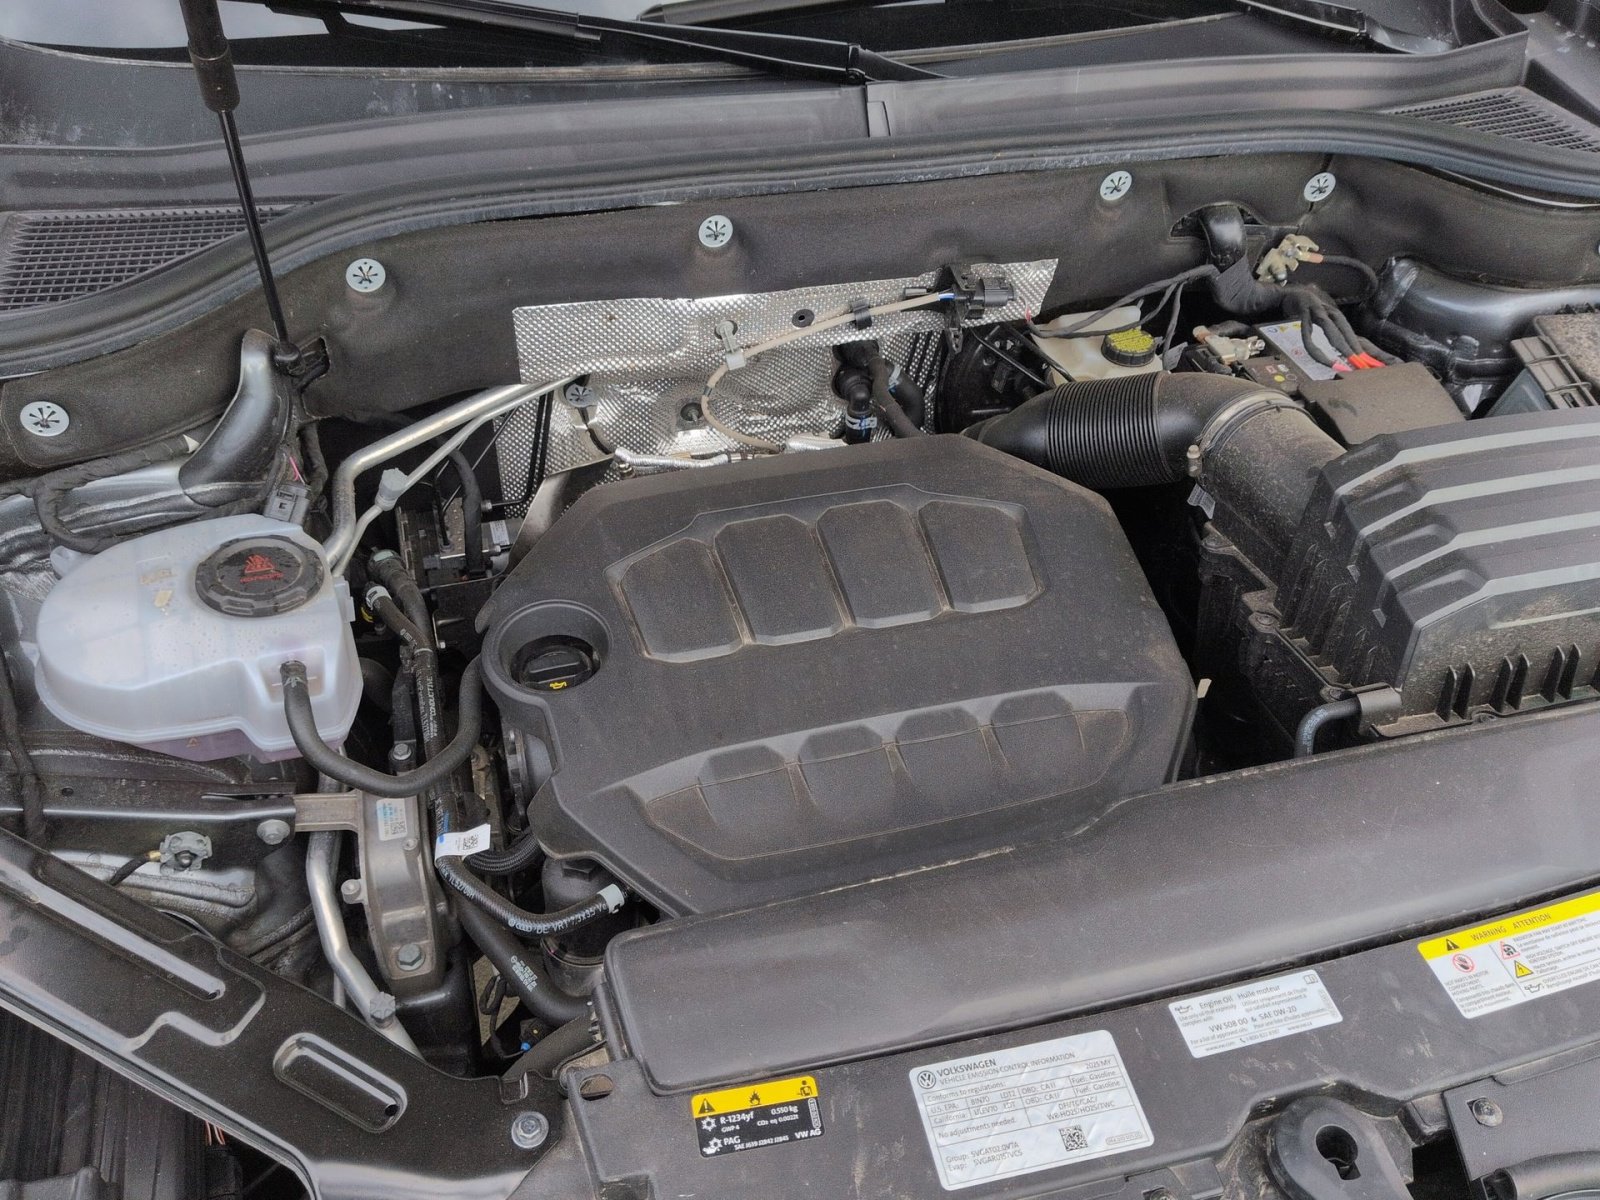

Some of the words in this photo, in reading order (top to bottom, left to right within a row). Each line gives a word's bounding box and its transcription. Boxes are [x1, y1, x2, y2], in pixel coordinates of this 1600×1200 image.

[1471, 926, 1507, 941] WARNING
[1512, 913, 1552, 929] ATTENTION
[1200, 999, 1223, 1010] Engine
[1238, 991, 1256, 1000] Huile
[1256, 985, 1281, 995] moteur
[1209, 1024, 1223, 1032] VW
[1223, 1020, 1238, 1029] 508
[1238, 1017, 1249, 1026] 00
[1259, 1012, 1273, 1020] SAE
[1273, 1005, 1297, 1017] 0W-20
[938, 1059, 996, 1077] VOLKSWAGEN
[940, 1075, 967, 1085] VEHICLE
[968, 1068, 999, 1079] EMISSION
[1001, 1062, 1030, 1073] CONTROL
[1030, 1052, 1075, 1066] INFORMATION
[928, 1090, 961, 1102] Conforms
[970, 1081, 1006, 1094] regulations:
[1022, 1086, 1039, 1094] OBD:
[1072, 1076, 1088, 1084] Fuel:
[1090, 1070, 1116, 1080] Gasoline
[1026, 1097, 1042, 1105] OBD:
[1076, 1086, 1092, 1094] Fuel:
[1093, 1080, 1120, 1090] Gasoline
[720, 1112, 755, 1126] R-1234yf
[771, 1107, 788, 1115] 0.550
[790, 1105, 798, 1113] kg
[795, 1131, 809, 1139] VW
[938, 1131, 949, 1139] No
[950, 1122, 991, 1137] adjustments
[992, 1117, 1016, 1127] needed.
[724, 1136, 741, 1145] PAG
[946, 1154, 968, 1164] Group:
